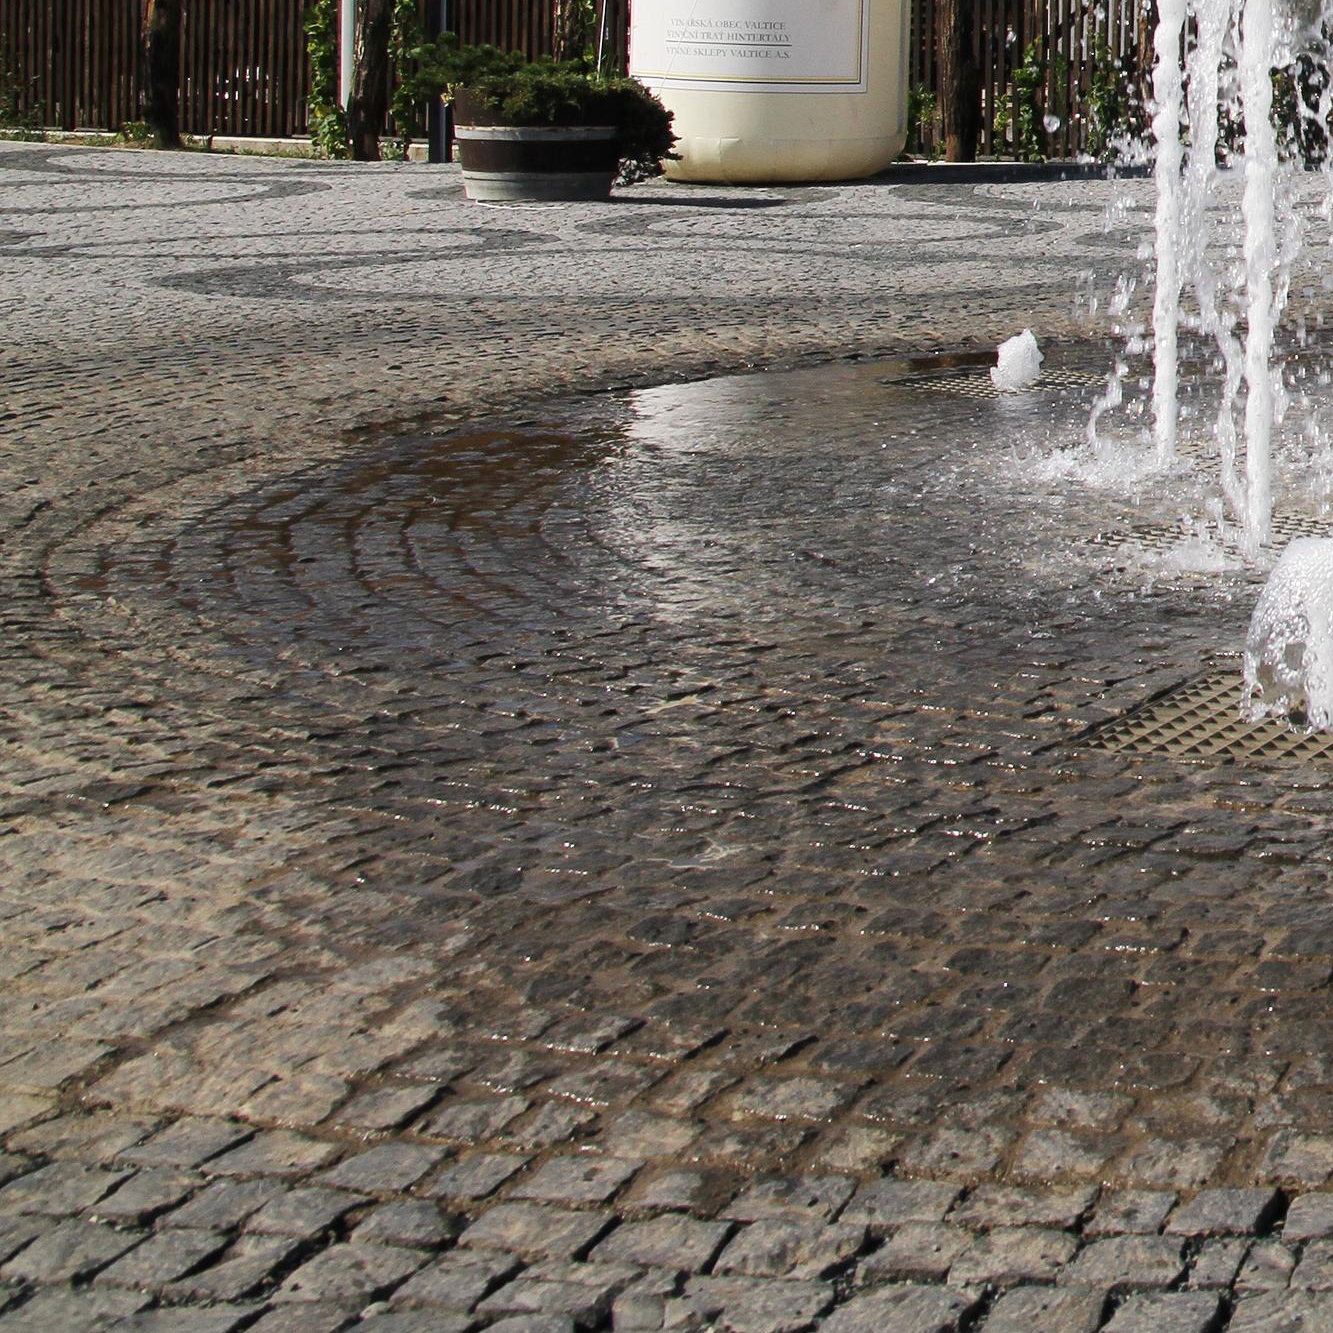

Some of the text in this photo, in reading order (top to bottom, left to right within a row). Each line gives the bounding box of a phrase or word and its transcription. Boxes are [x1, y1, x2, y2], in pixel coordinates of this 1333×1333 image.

[744, 21, 786, 30] VALTICE
[693, 48, 728, 57] SKLEPY
[731, 49, 772, 59] VALTICE
